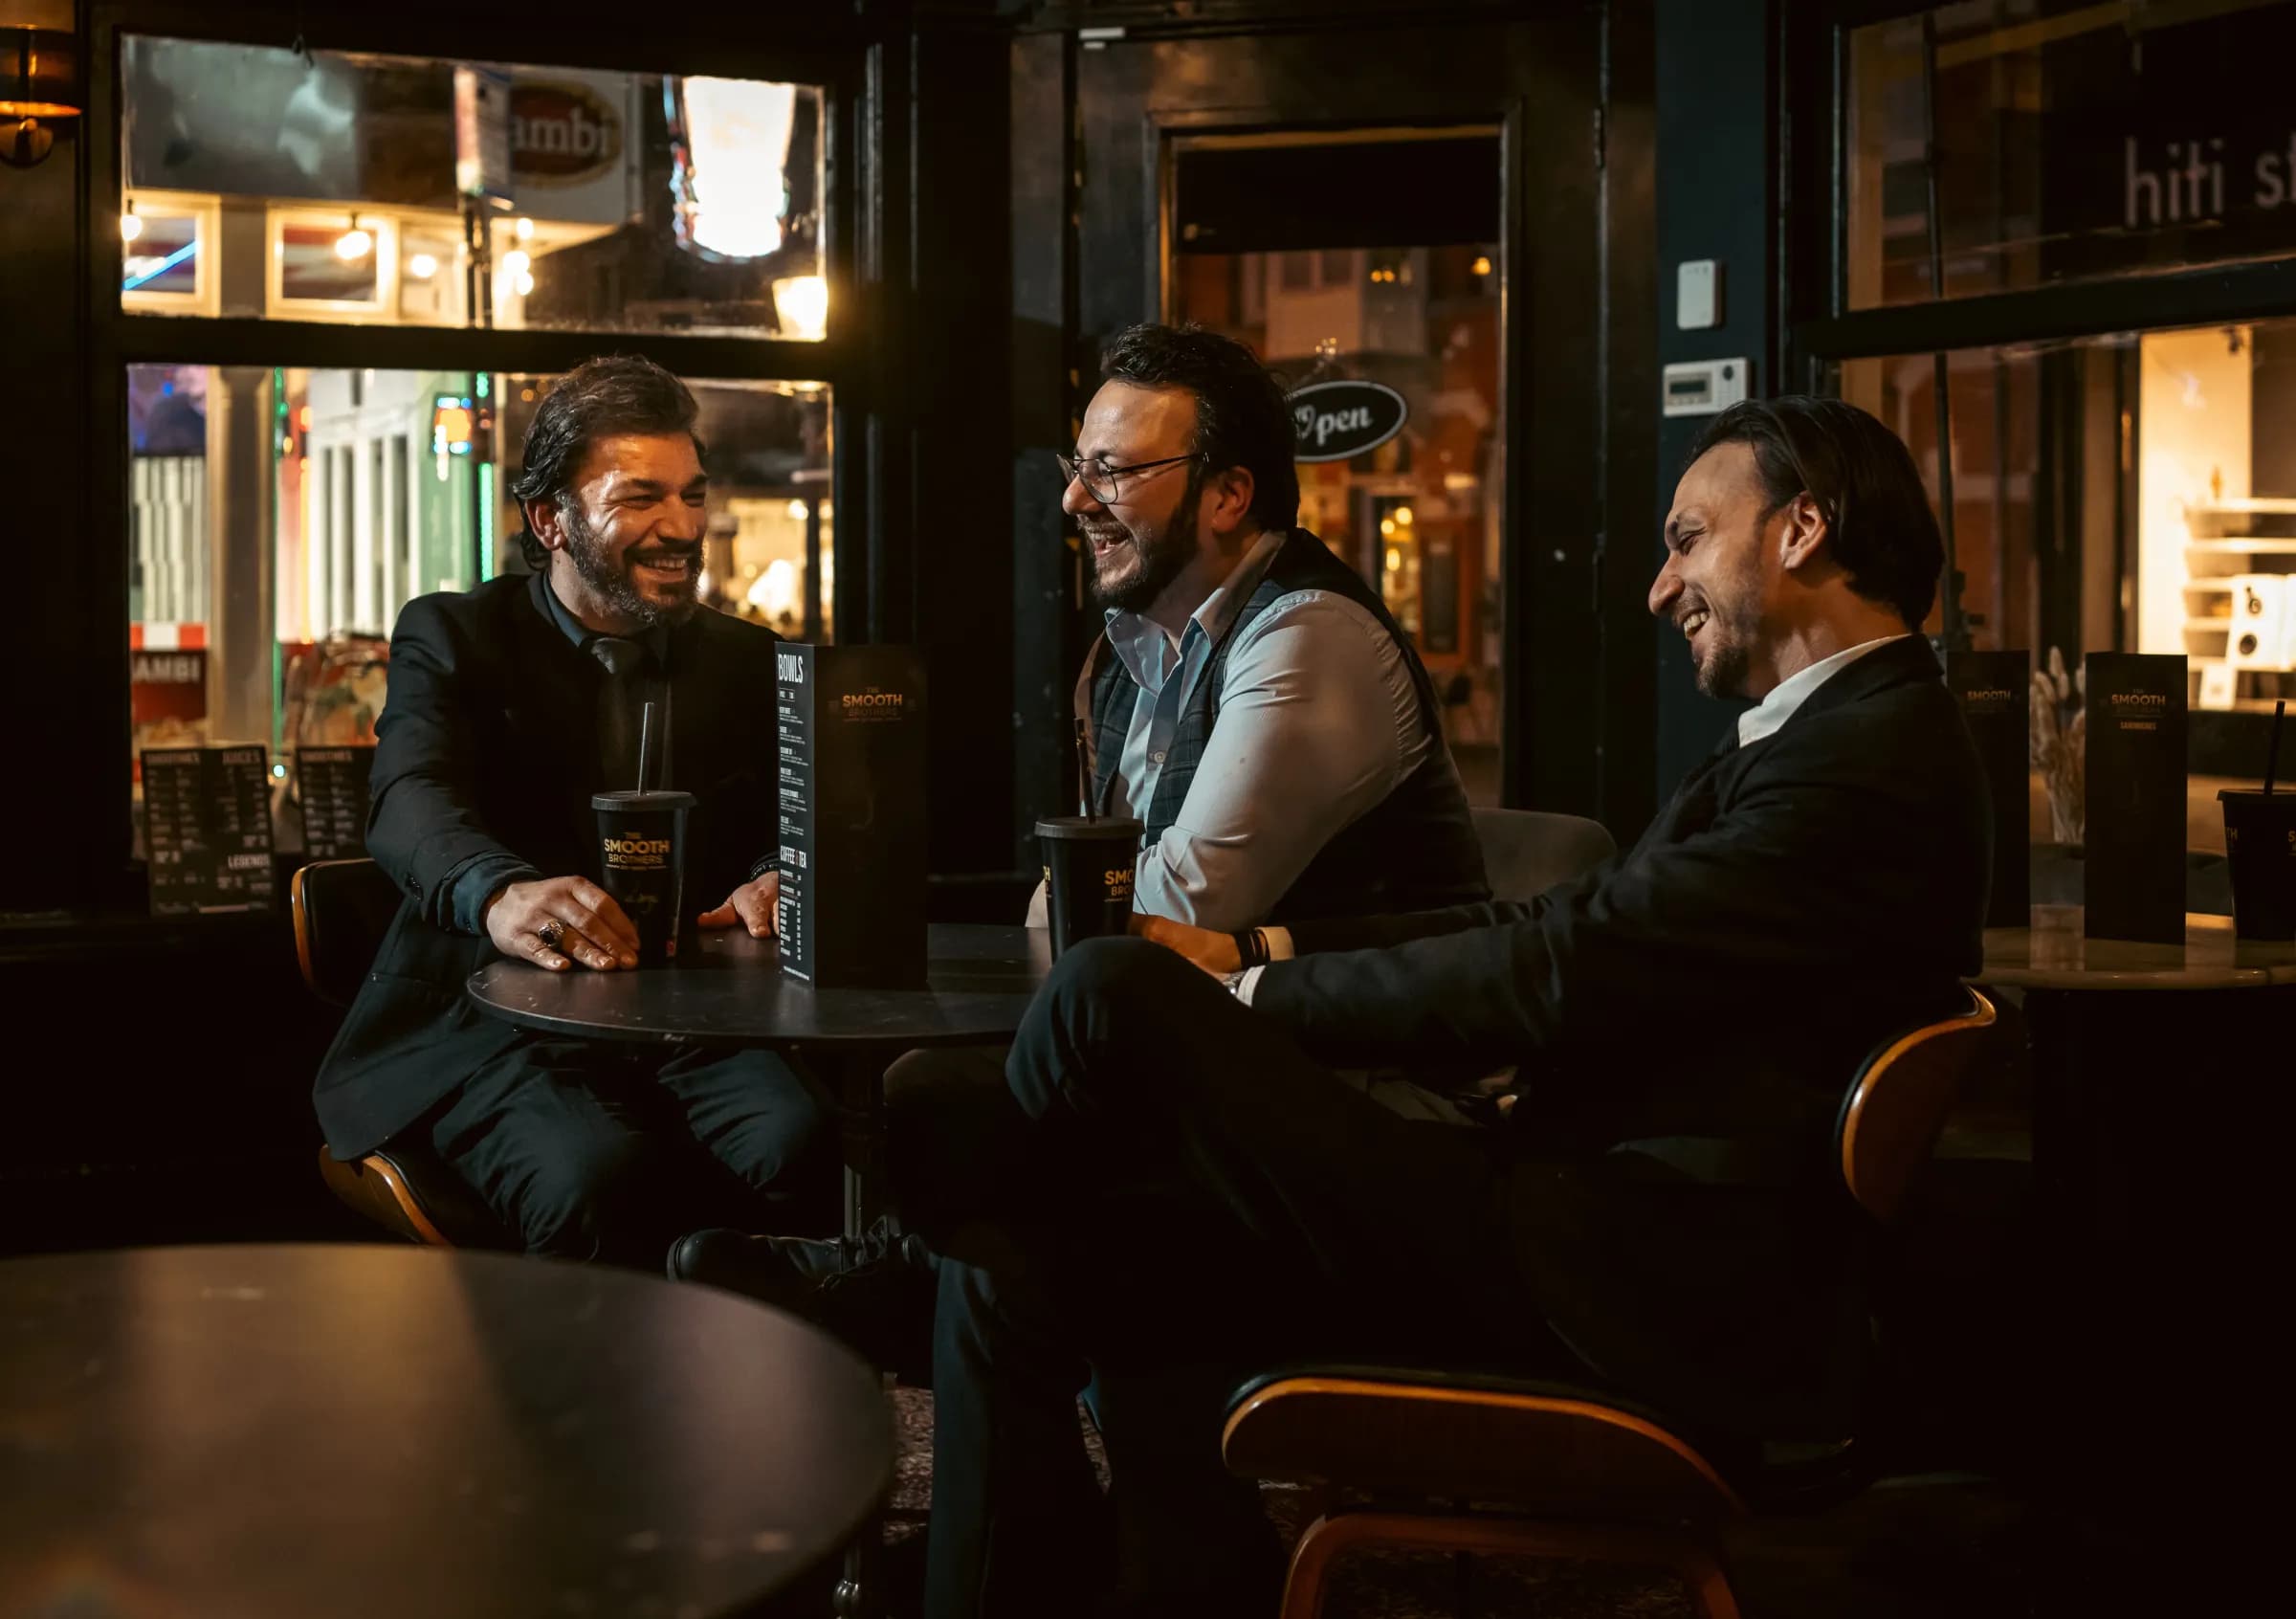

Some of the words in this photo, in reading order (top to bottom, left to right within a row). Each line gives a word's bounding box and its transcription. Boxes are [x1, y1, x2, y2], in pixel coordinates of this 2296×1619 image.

[1294, 404, 1374, 447] Open
[778, 654, 804, 683] BOWLS
[842, 694, 903, 708] SMOOTH
[1967, 690, 2011, 702] SMOOTH
[2111, 694, 2166, 705] SMOOTH
[604, 837, 671, 854] SMOOTH
[780, 845, 796, 865] COFFEE
[799, 851, 807, 869] TEA
